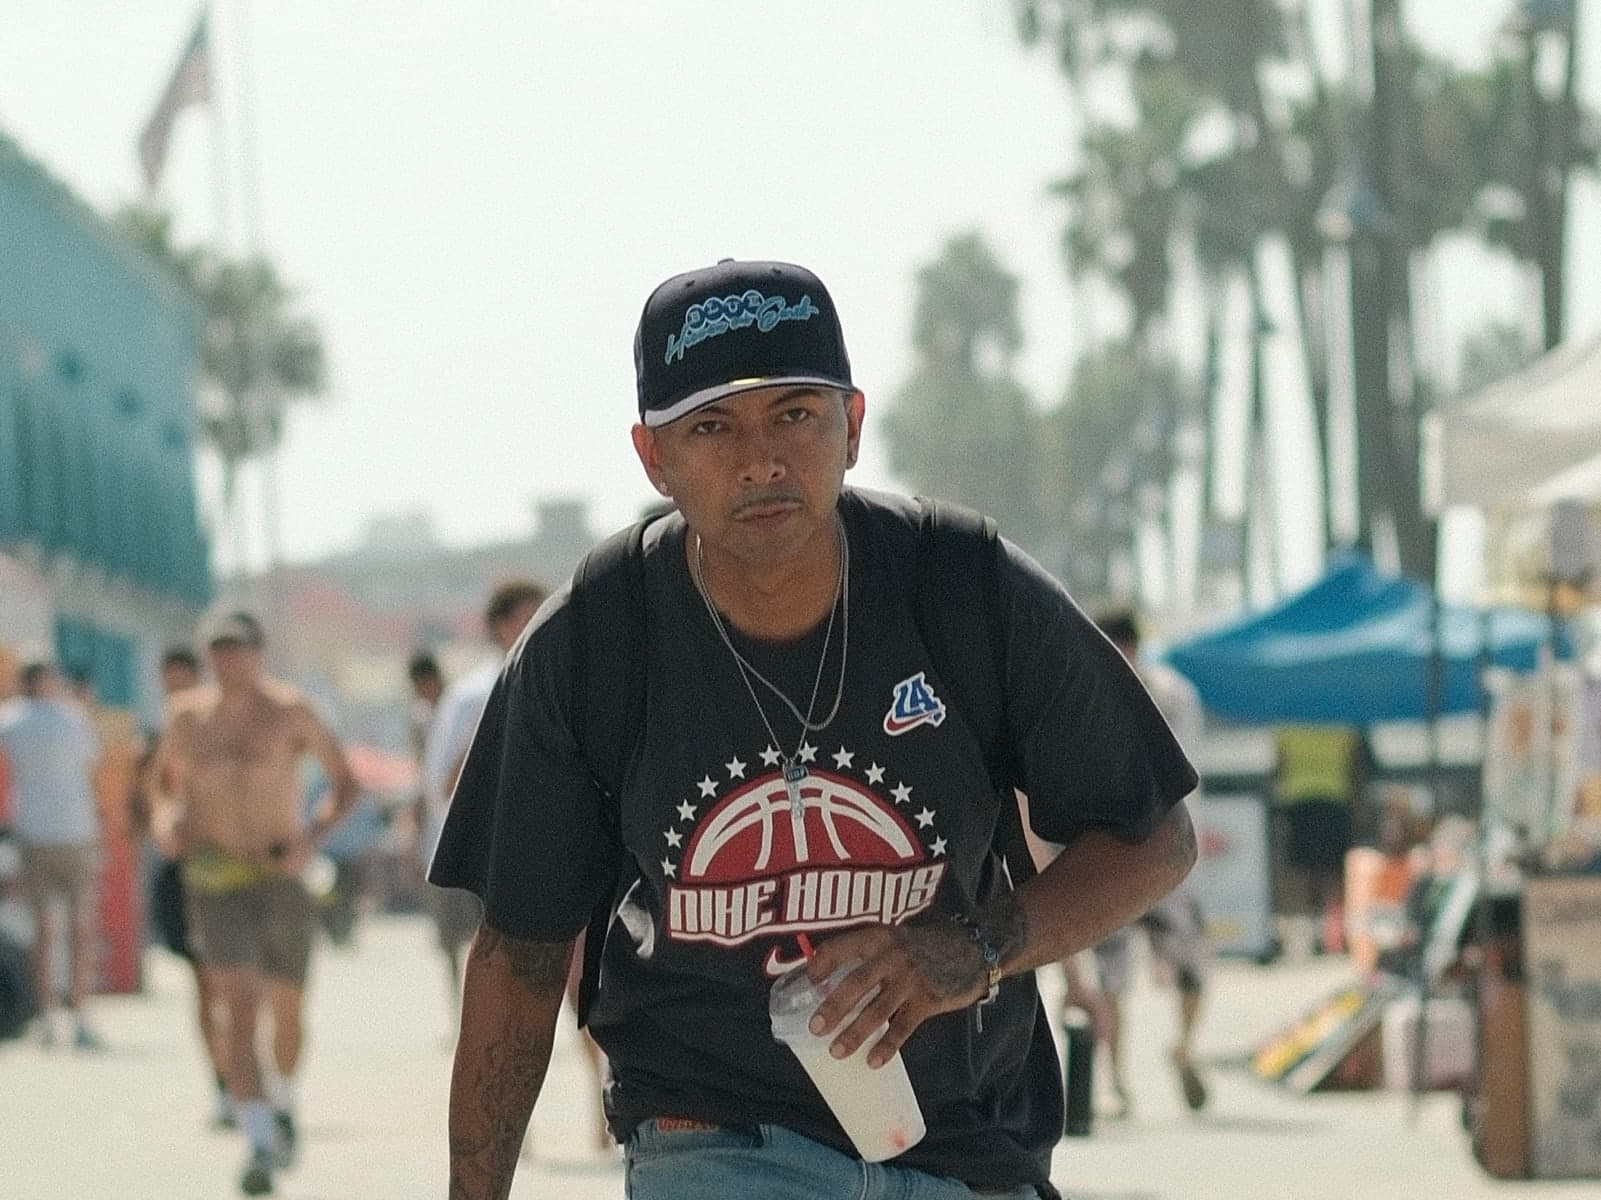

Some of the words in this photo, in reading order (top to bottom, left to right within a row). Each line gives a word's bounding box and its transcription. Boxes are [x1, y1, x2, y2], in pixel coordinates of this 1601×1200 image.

[893, 671, 946, 727] LA
[670, 880, 776, 937] NIKE
[786, 863, 944, 925] HOOPS
